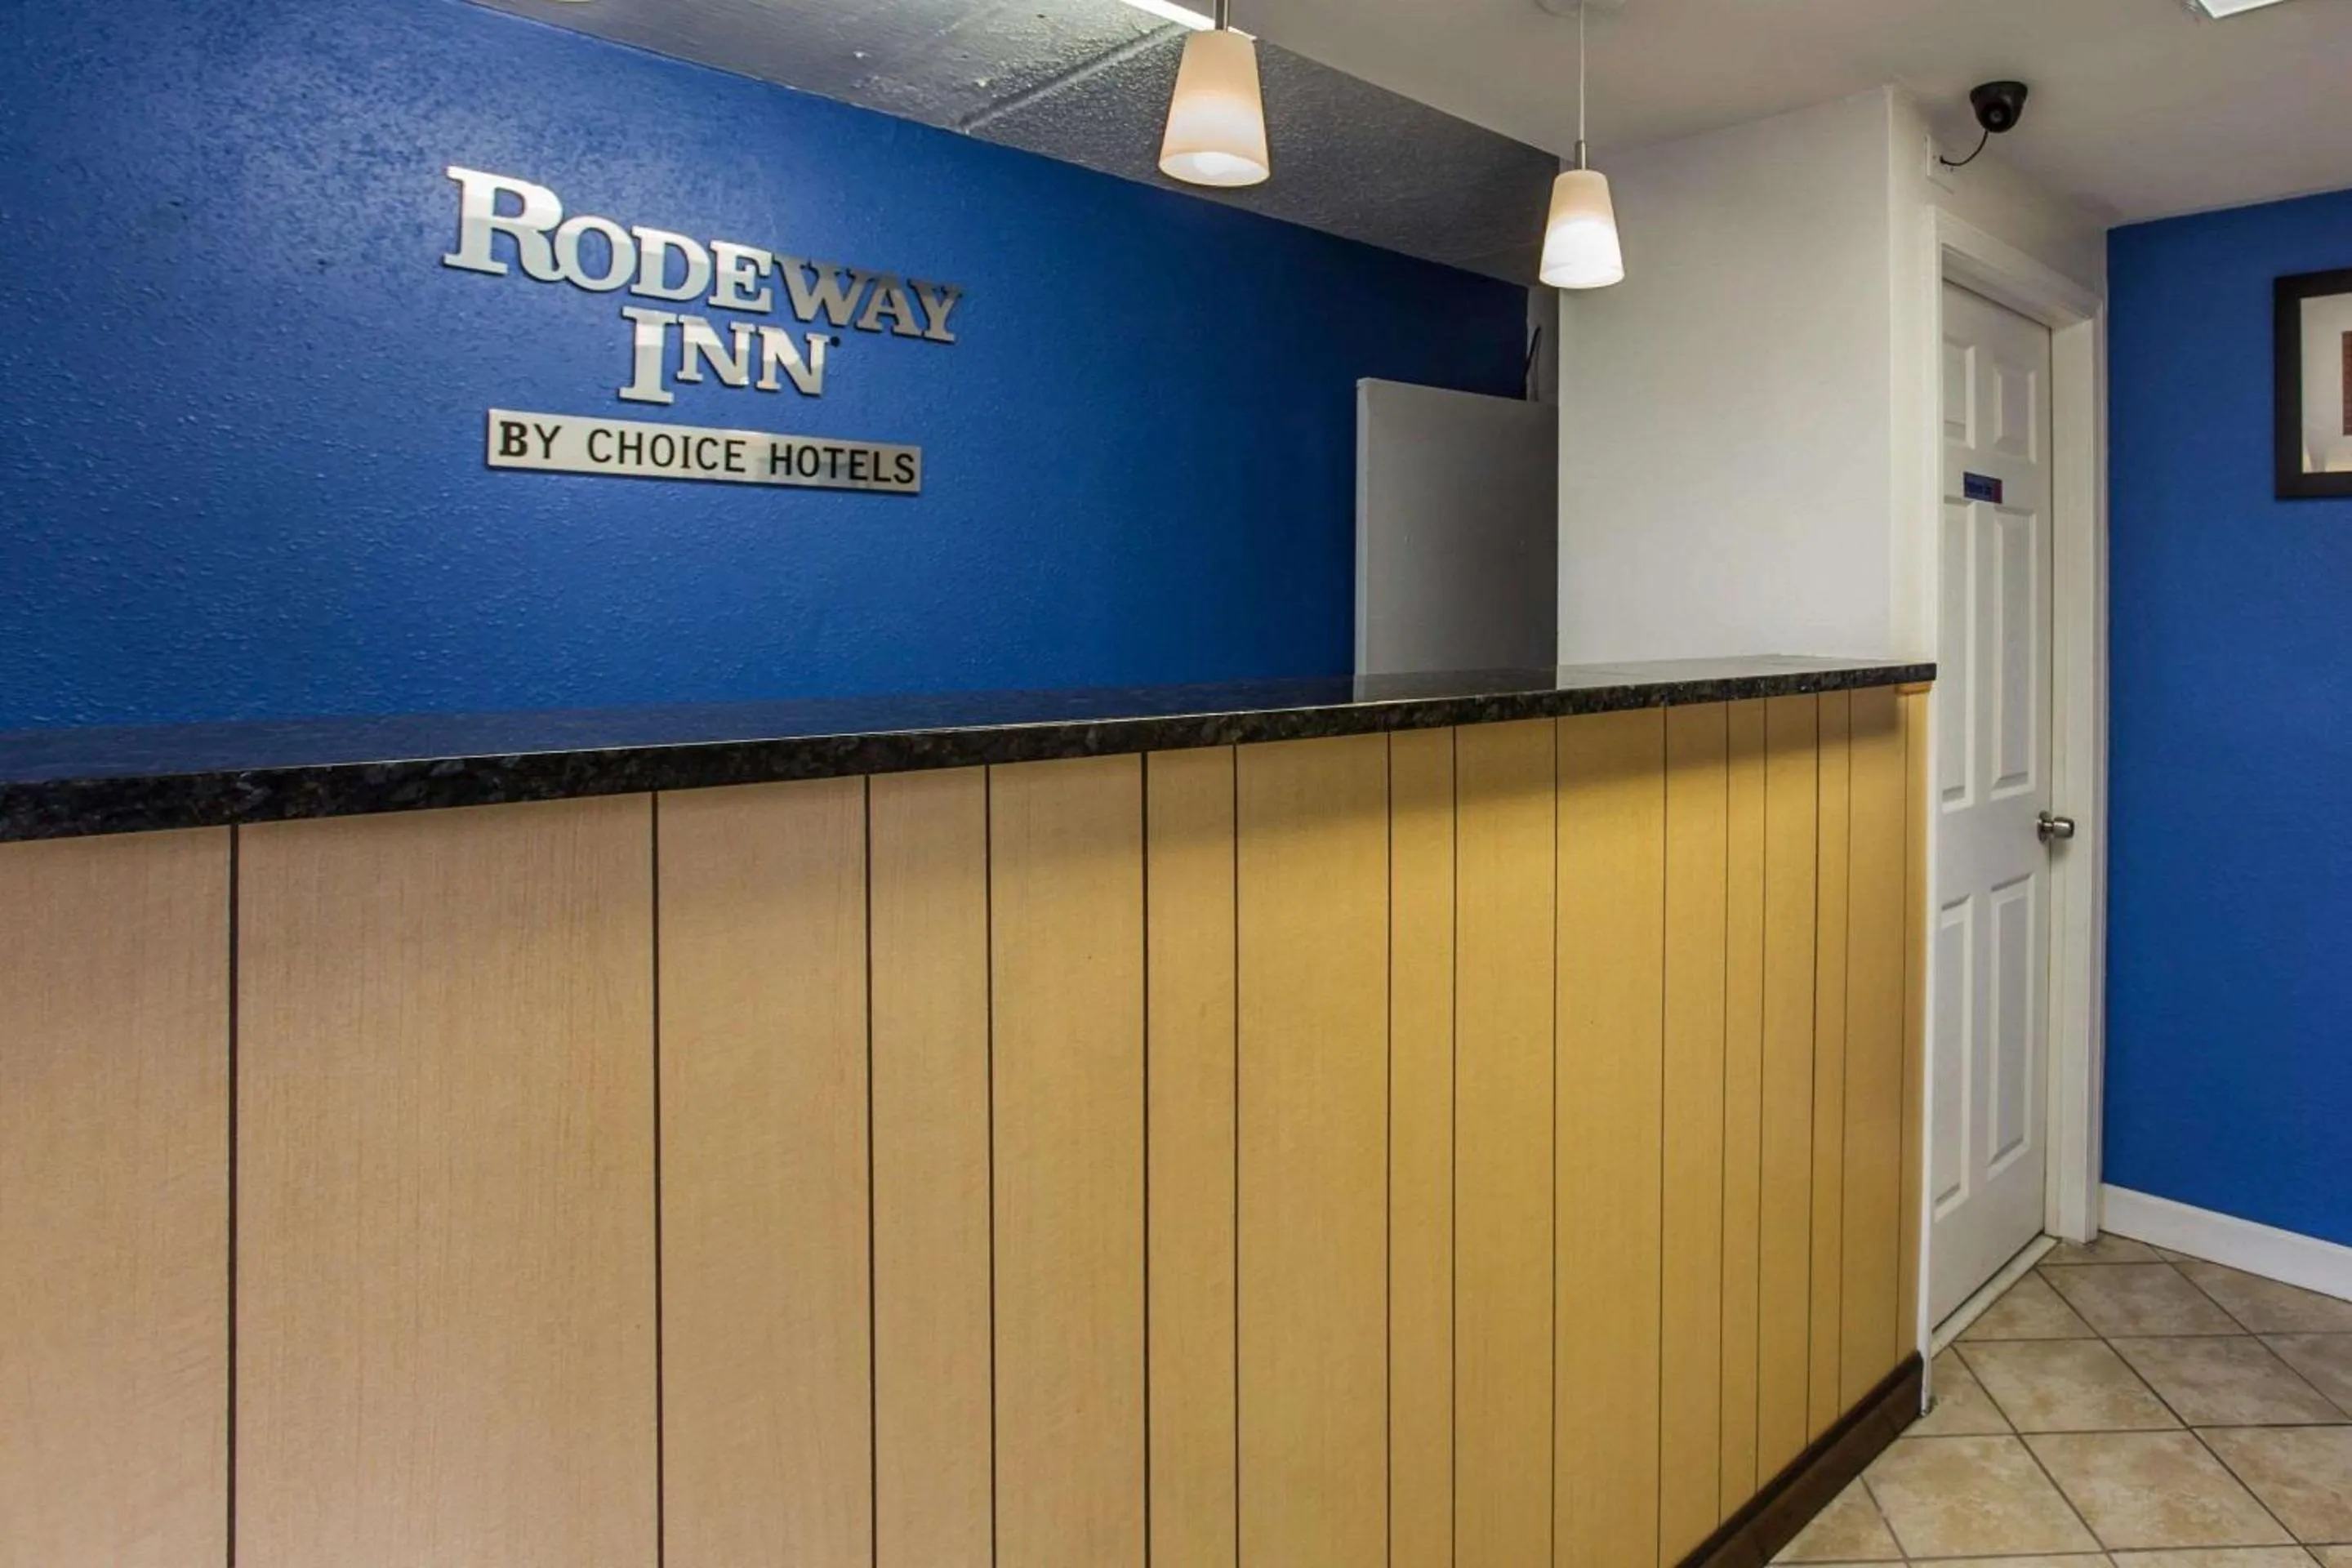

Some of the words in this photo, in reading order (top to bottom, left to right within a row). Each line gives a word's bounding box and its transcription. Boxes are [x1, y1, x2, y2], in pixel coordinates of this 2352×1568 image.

[443, 166, 962, 343] RODEWAY
[618, 305, 831, 404] INN
[499, 421, 561, 459] BY
[587, 428, 746, 472] CHOICE
[769, 443, 915, 485] HOTELS
